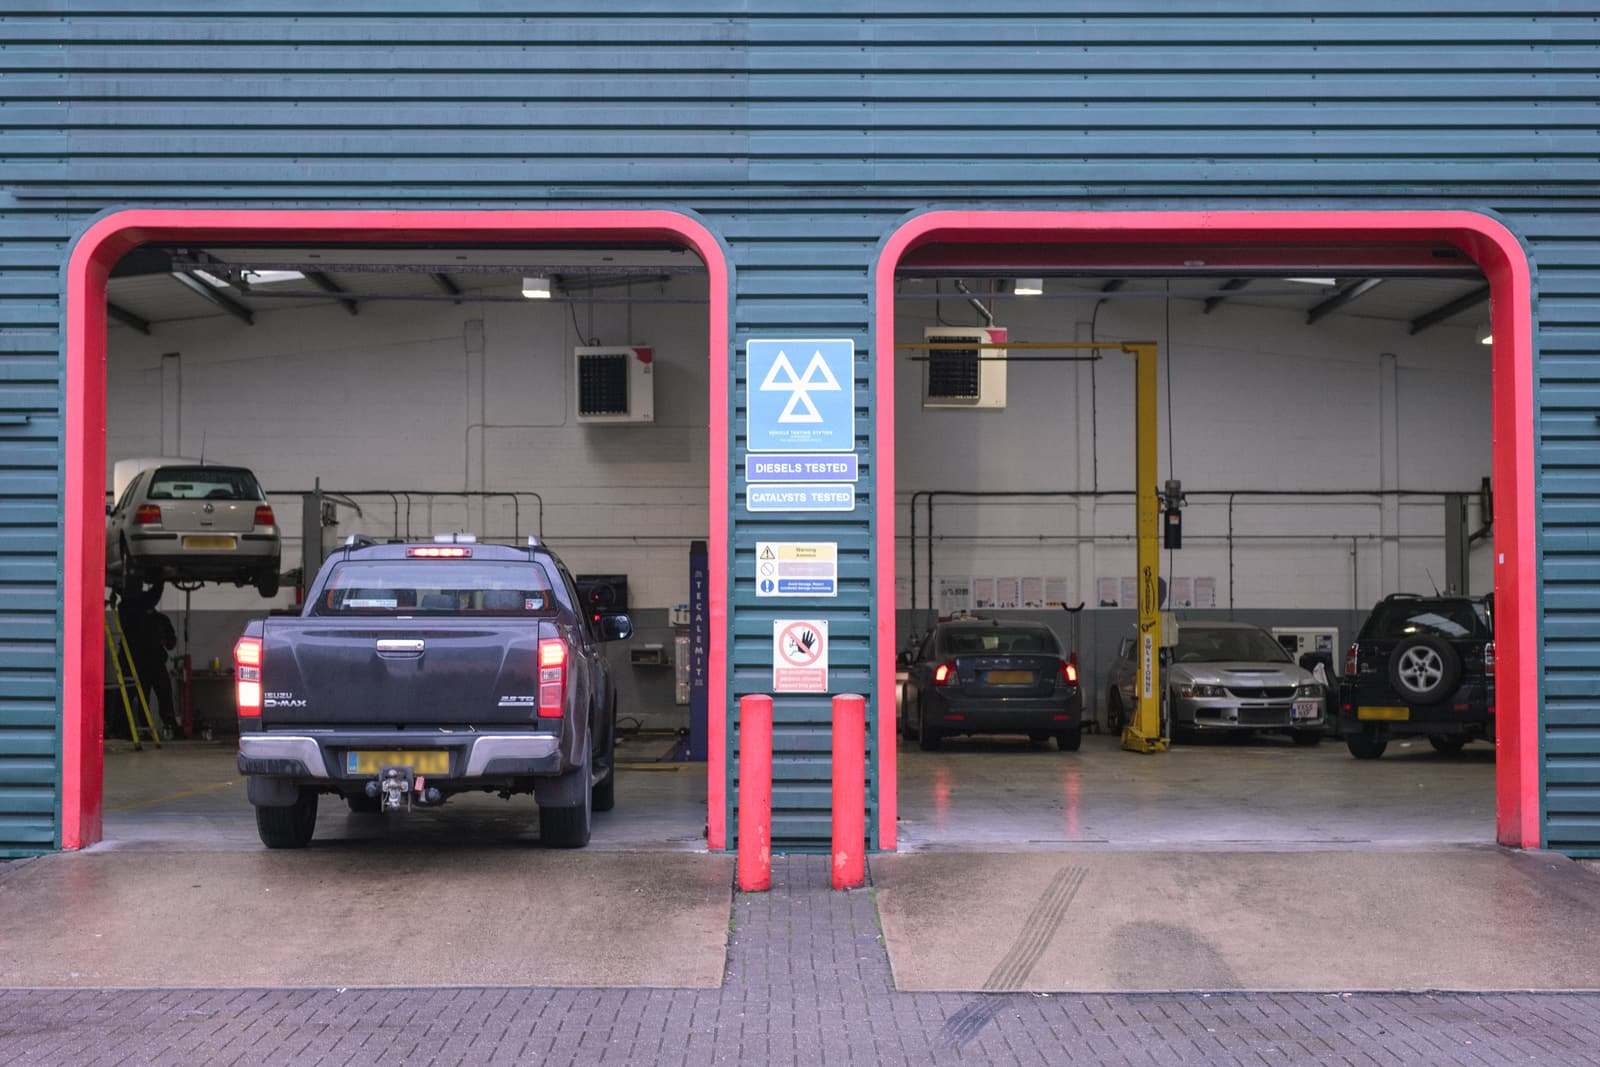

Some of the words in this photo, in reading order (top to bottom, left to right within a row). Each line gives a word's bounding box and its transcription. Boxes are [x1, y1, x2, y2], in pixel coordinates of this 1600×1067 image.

[755, 463, 802, 473] DIESELS
[805, 463, 848, 473] TESTED
[752, 493, 807, 502] CATALYSTS
[811, 492, 850, 502] TESTED
[694, 581, 704, 676] TECALEMIT
[264, 699, 307, 707] D-MAX
